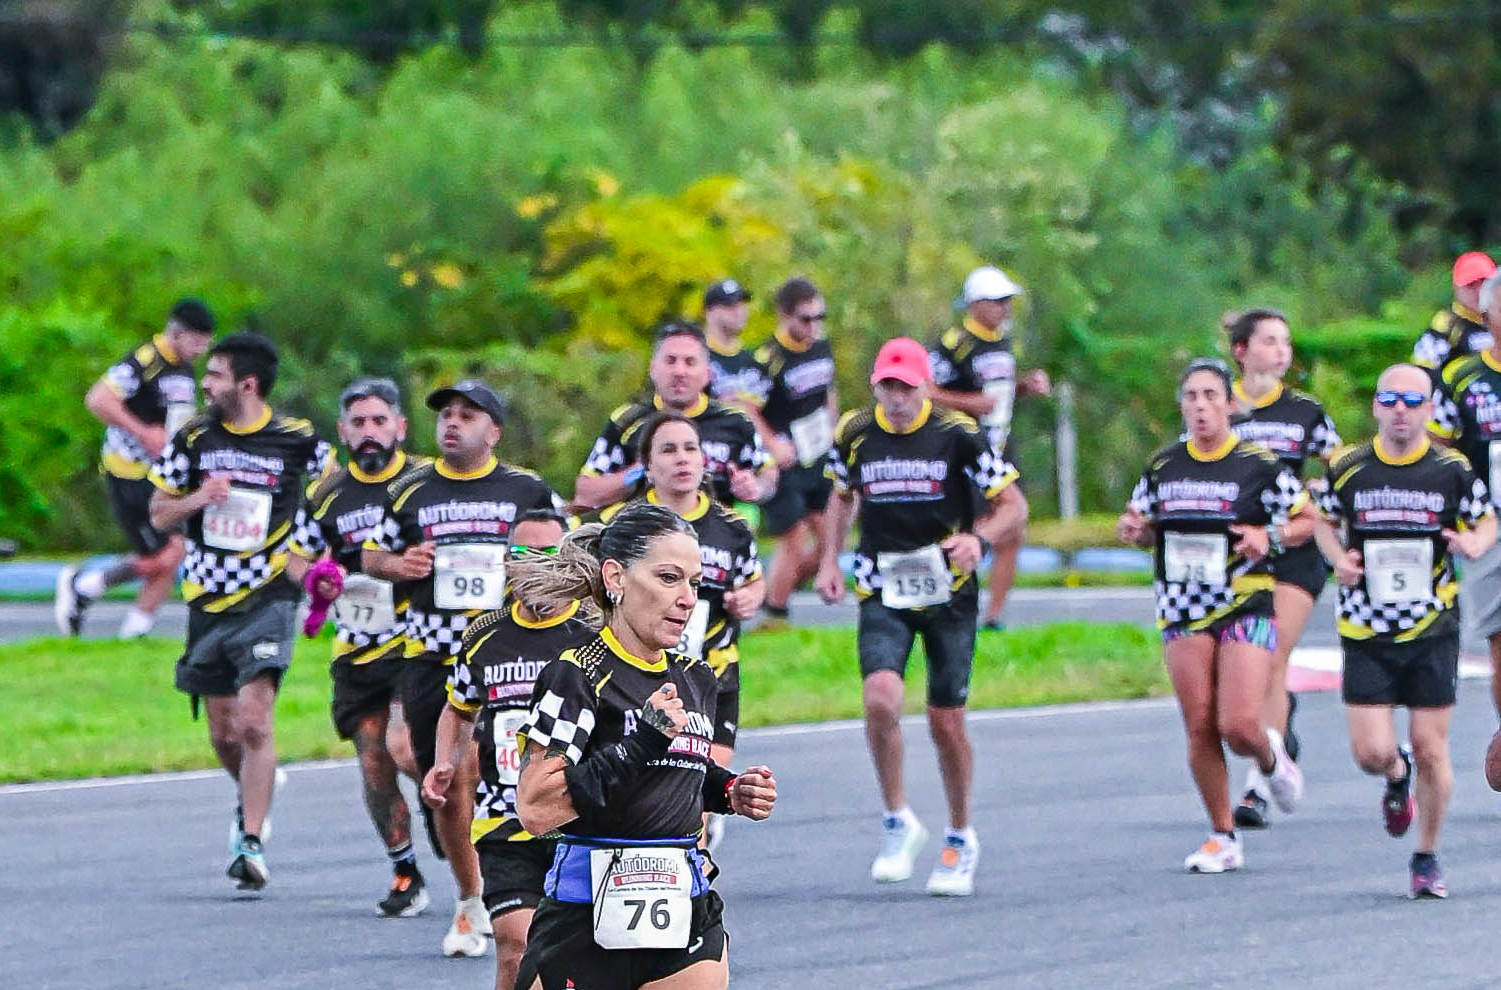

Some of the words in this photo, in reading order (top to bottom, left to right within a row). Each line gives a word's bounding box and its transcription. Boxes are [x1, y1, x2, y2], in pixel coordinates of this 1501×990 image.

[454, 577, 485, 597] 98
[353, 604, 374, 624] 77
[691, 738, 710, 759] RACE
[610, 853, 680, 875] AUTÓDROMO
[623, 898, 671, 931] 76
